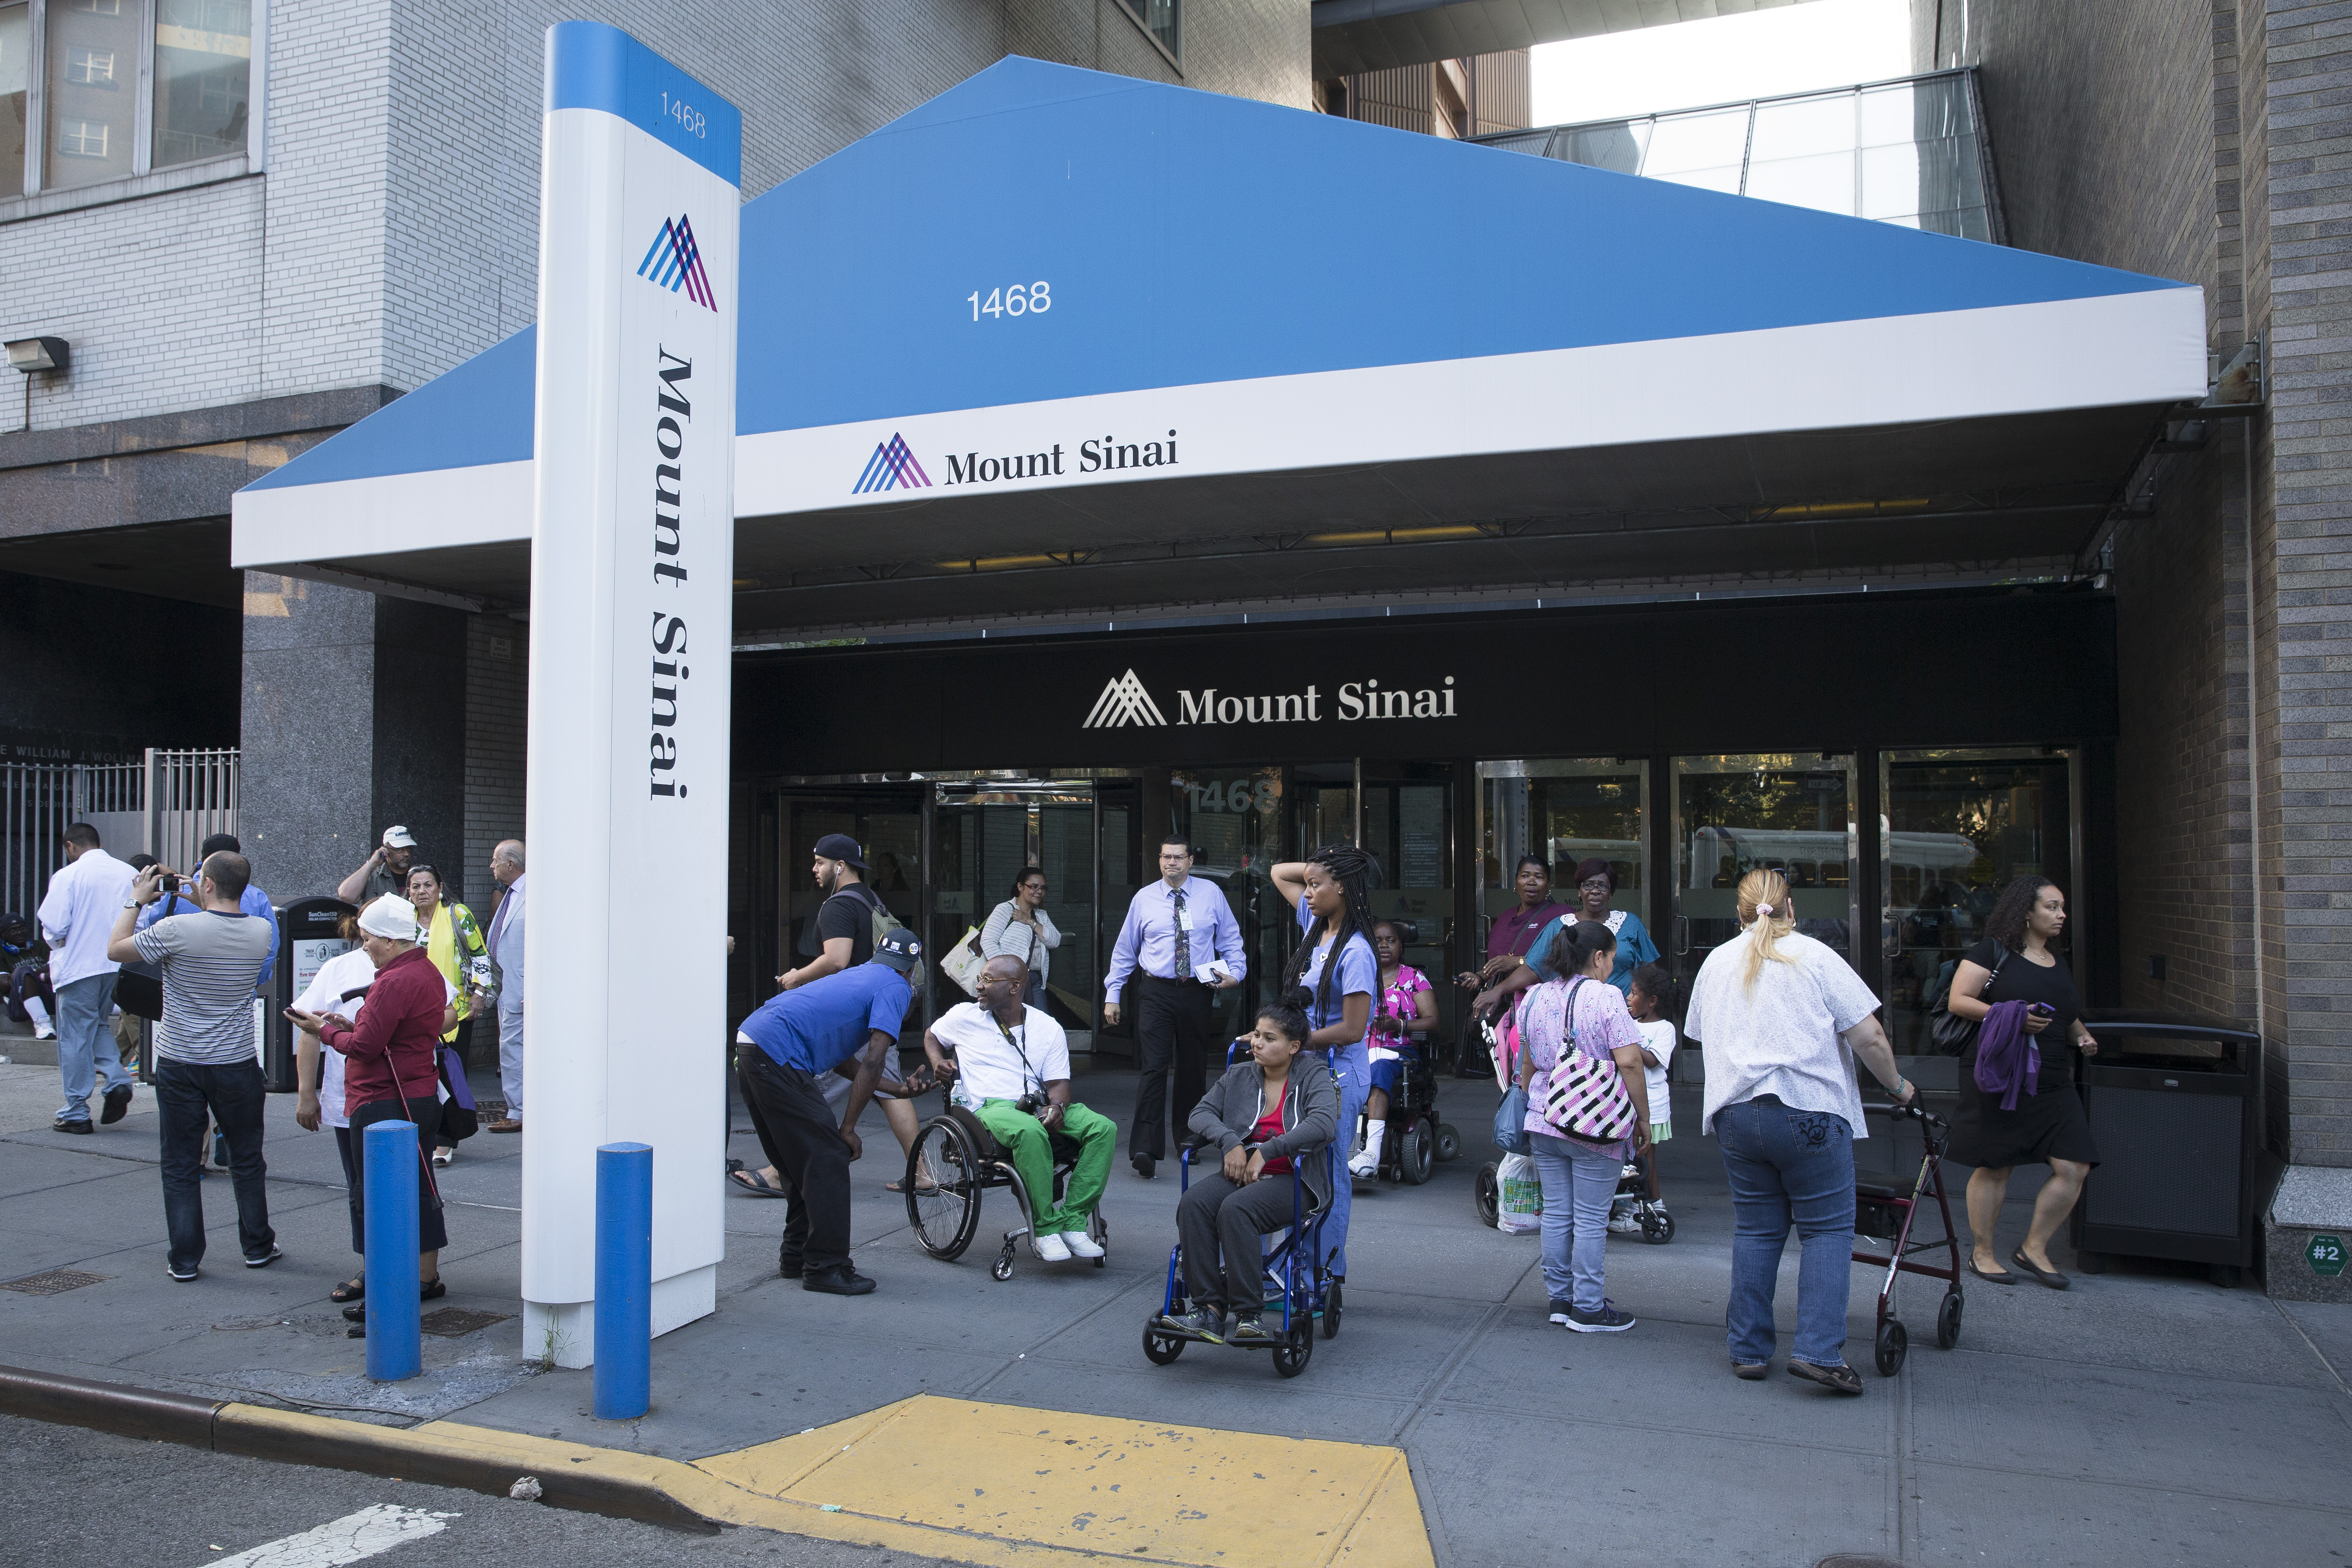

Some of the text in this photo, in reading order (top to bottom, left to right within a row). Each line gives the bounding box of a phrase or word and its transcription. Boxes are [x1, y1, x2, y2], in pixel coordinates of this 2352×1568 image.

[661, 91, 706, 139] 1468
[967, 281, 1051, 322] 1468
[944, 429, 1179, 485] Mount Sinai
[650, 343, 692, 801] Mount Sinai
[1176, 676, 1457, 725] Mount Sinai
[16, 746, 71, 759] WILLIAM
[93, 752, 145, 763] WOLLMA
[1182, 780, 1278, 813] 1468
[1001, 1023, 1009, 1035] Nikon
[2313, 1245, 2339, 1261] #2
